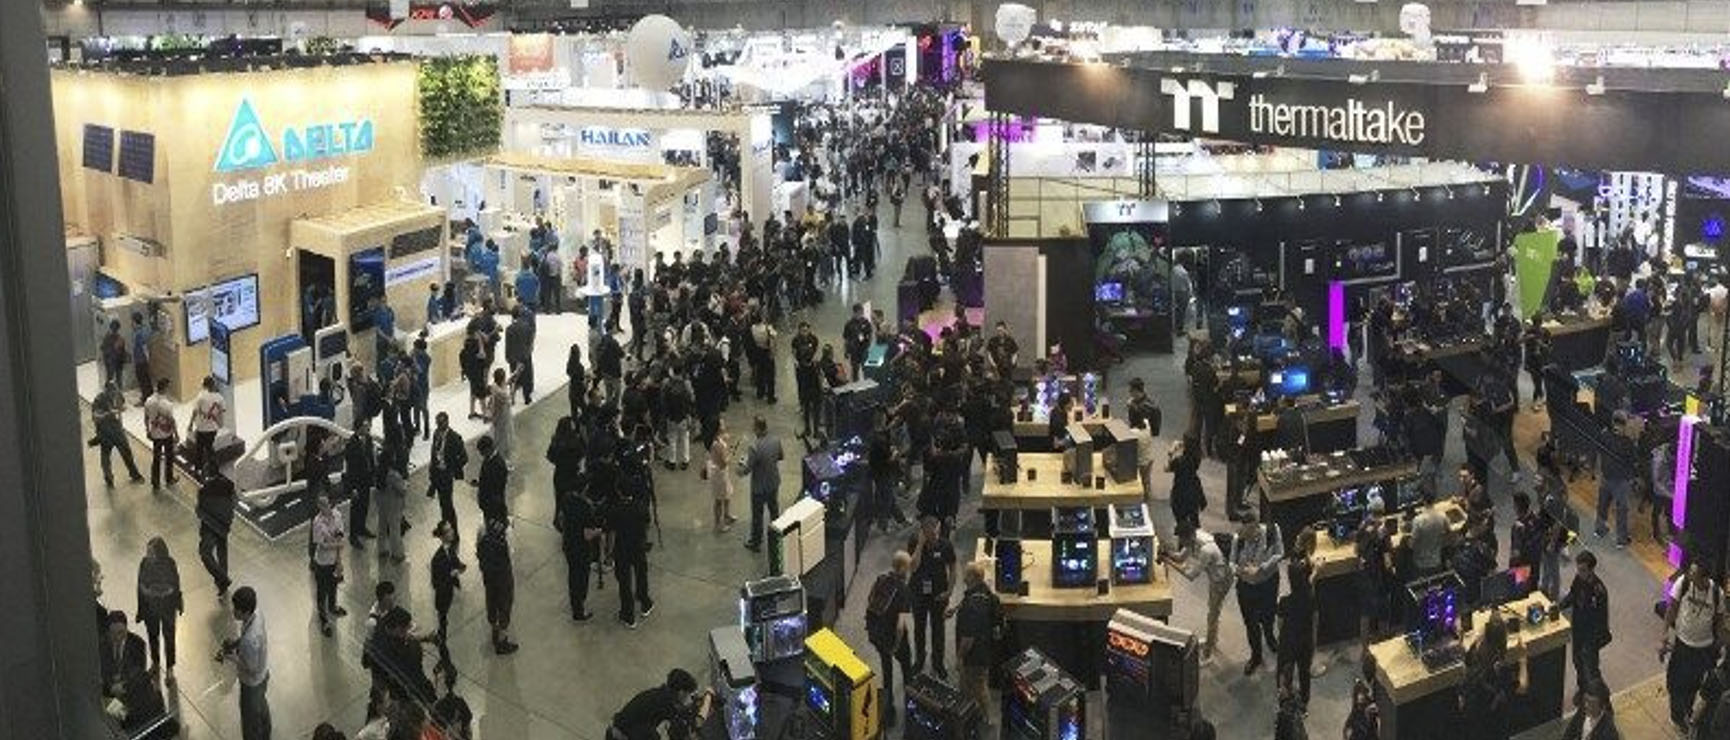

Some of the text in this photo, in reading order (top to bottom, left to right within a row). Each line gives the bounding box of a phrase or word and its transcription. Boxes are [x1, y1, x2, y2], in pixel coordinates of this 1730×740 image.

[283, 119, 374, 162] DELTA
[1249, 94, 1425, 145] thermaltake
[213, 165, 349, 206] Delta 8K Theater
